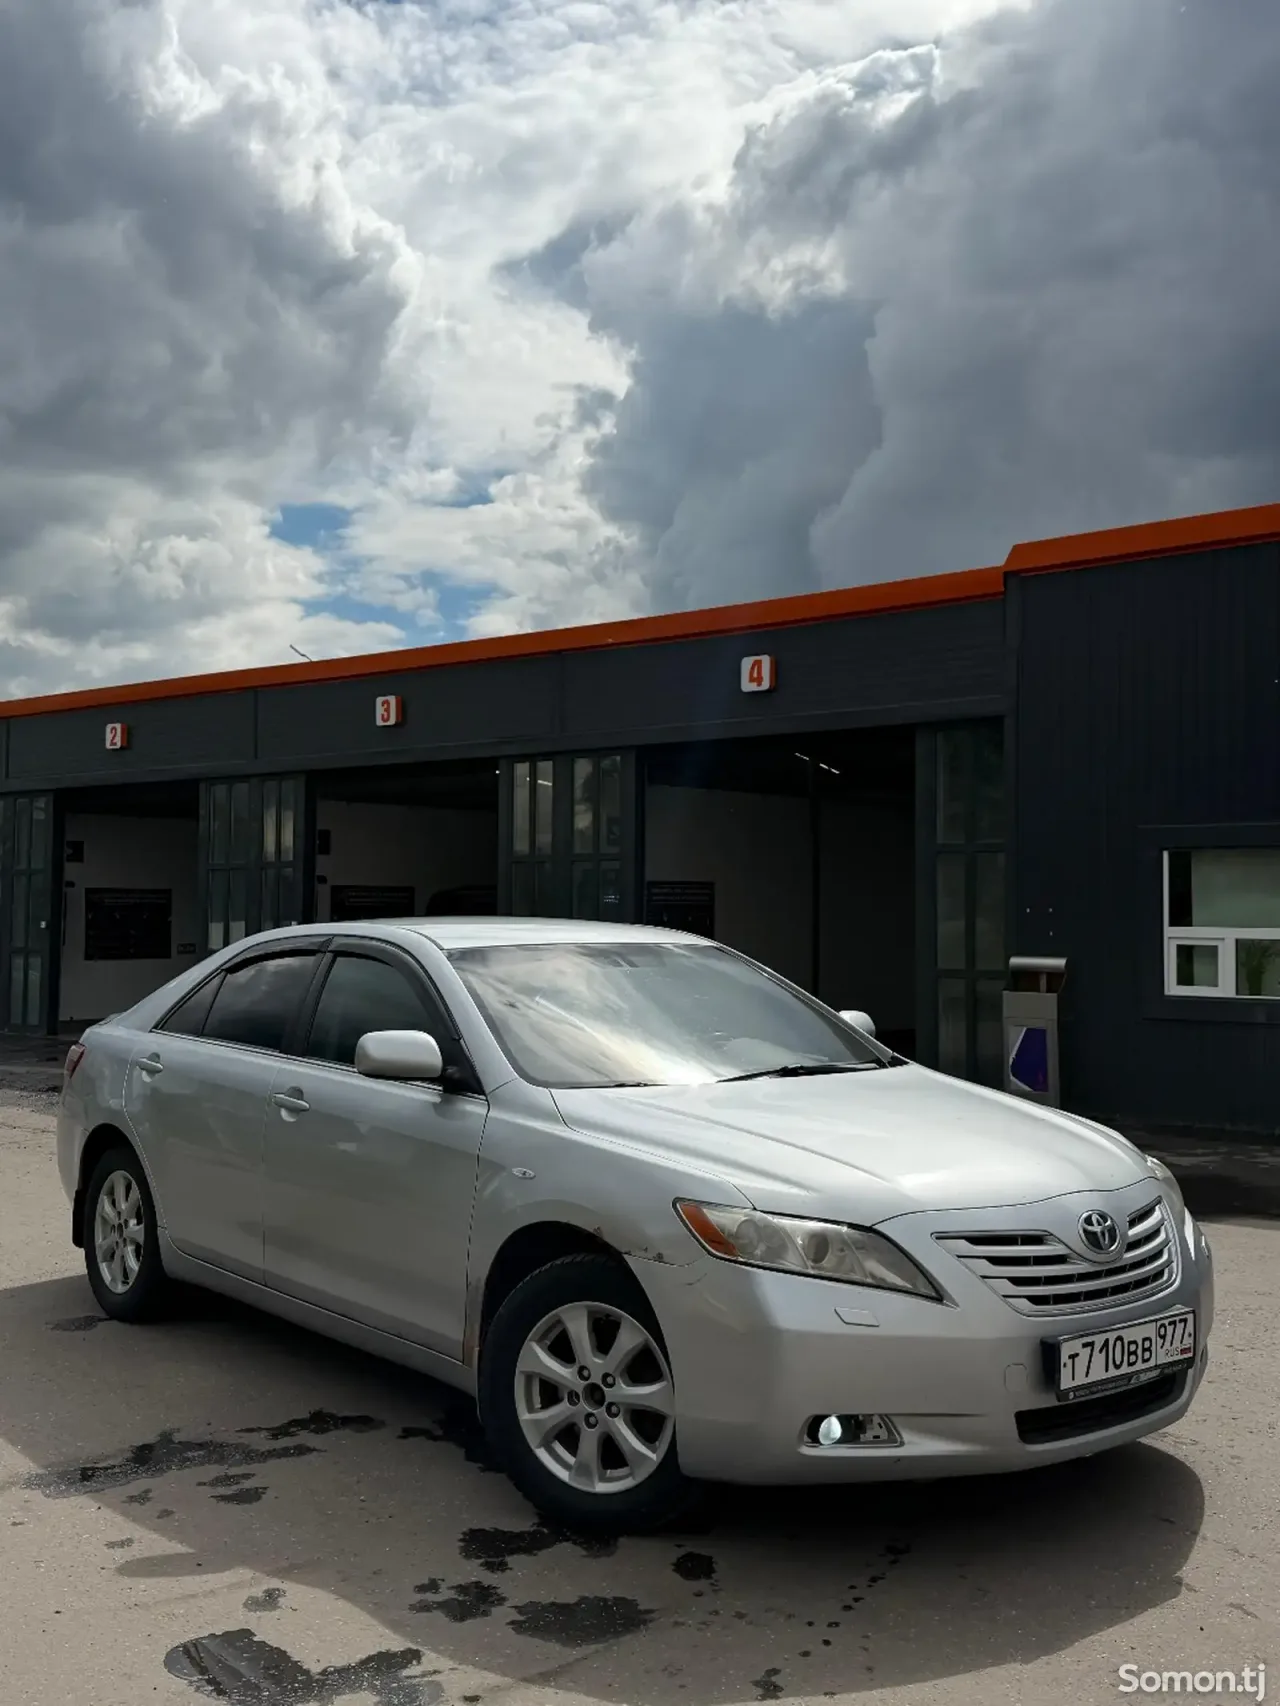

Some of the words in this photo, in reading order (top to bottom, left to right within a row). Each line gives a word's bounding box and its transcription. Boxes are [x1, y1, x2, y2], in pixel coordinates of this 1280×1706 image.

[748, 659, 764, 687] 4
[381, 699, 391, 723] 3
[110, 726, 117, 746] 2
[1158, 1317, 1188, 1349] 977
[1165, 1346, 1180, 1359] RUS
